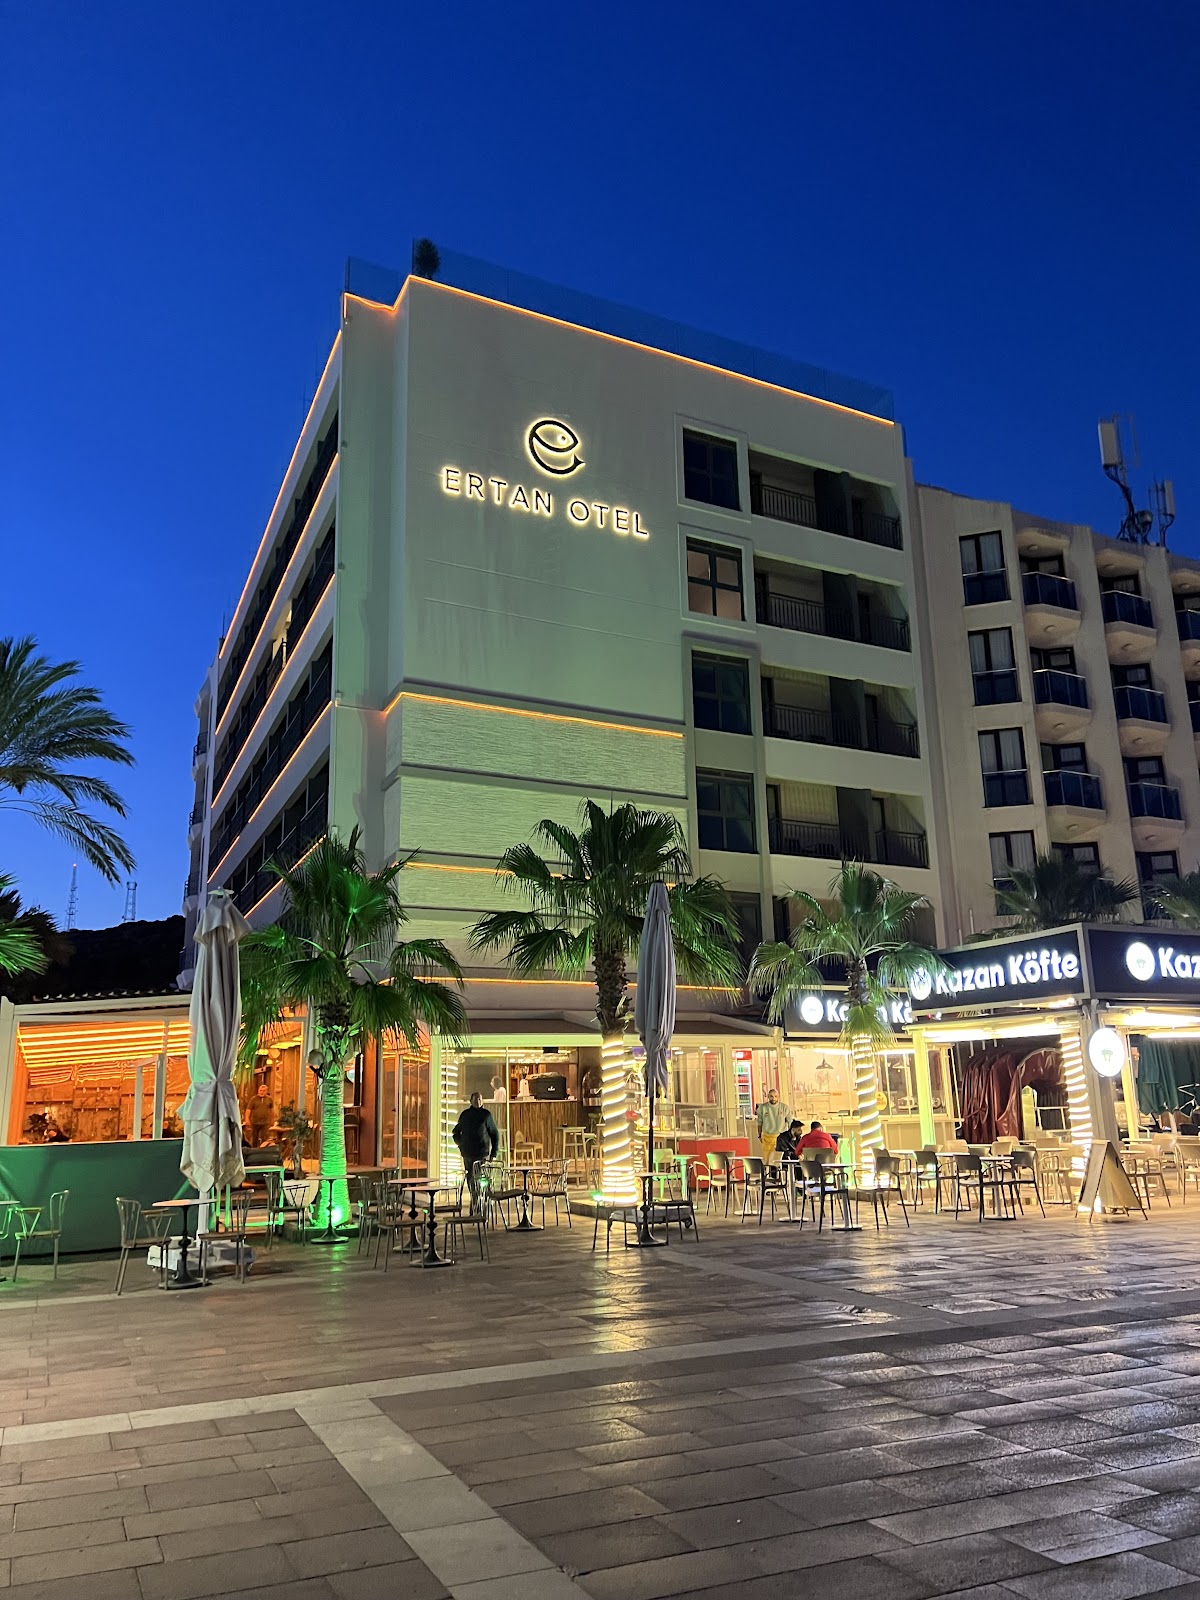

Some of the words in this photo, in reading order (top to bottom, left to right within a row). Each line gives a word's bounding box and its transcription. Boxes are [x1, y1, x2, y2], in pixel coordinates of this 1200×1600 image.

[444, 468, 552, 514] ERTAN
[569, 500, 649, 536] OTEL
[935, 964, 1005, 995] Kazan
[1008, 949, 1080, 986] Köfte
[826, 999, 888, 1023] Kan
